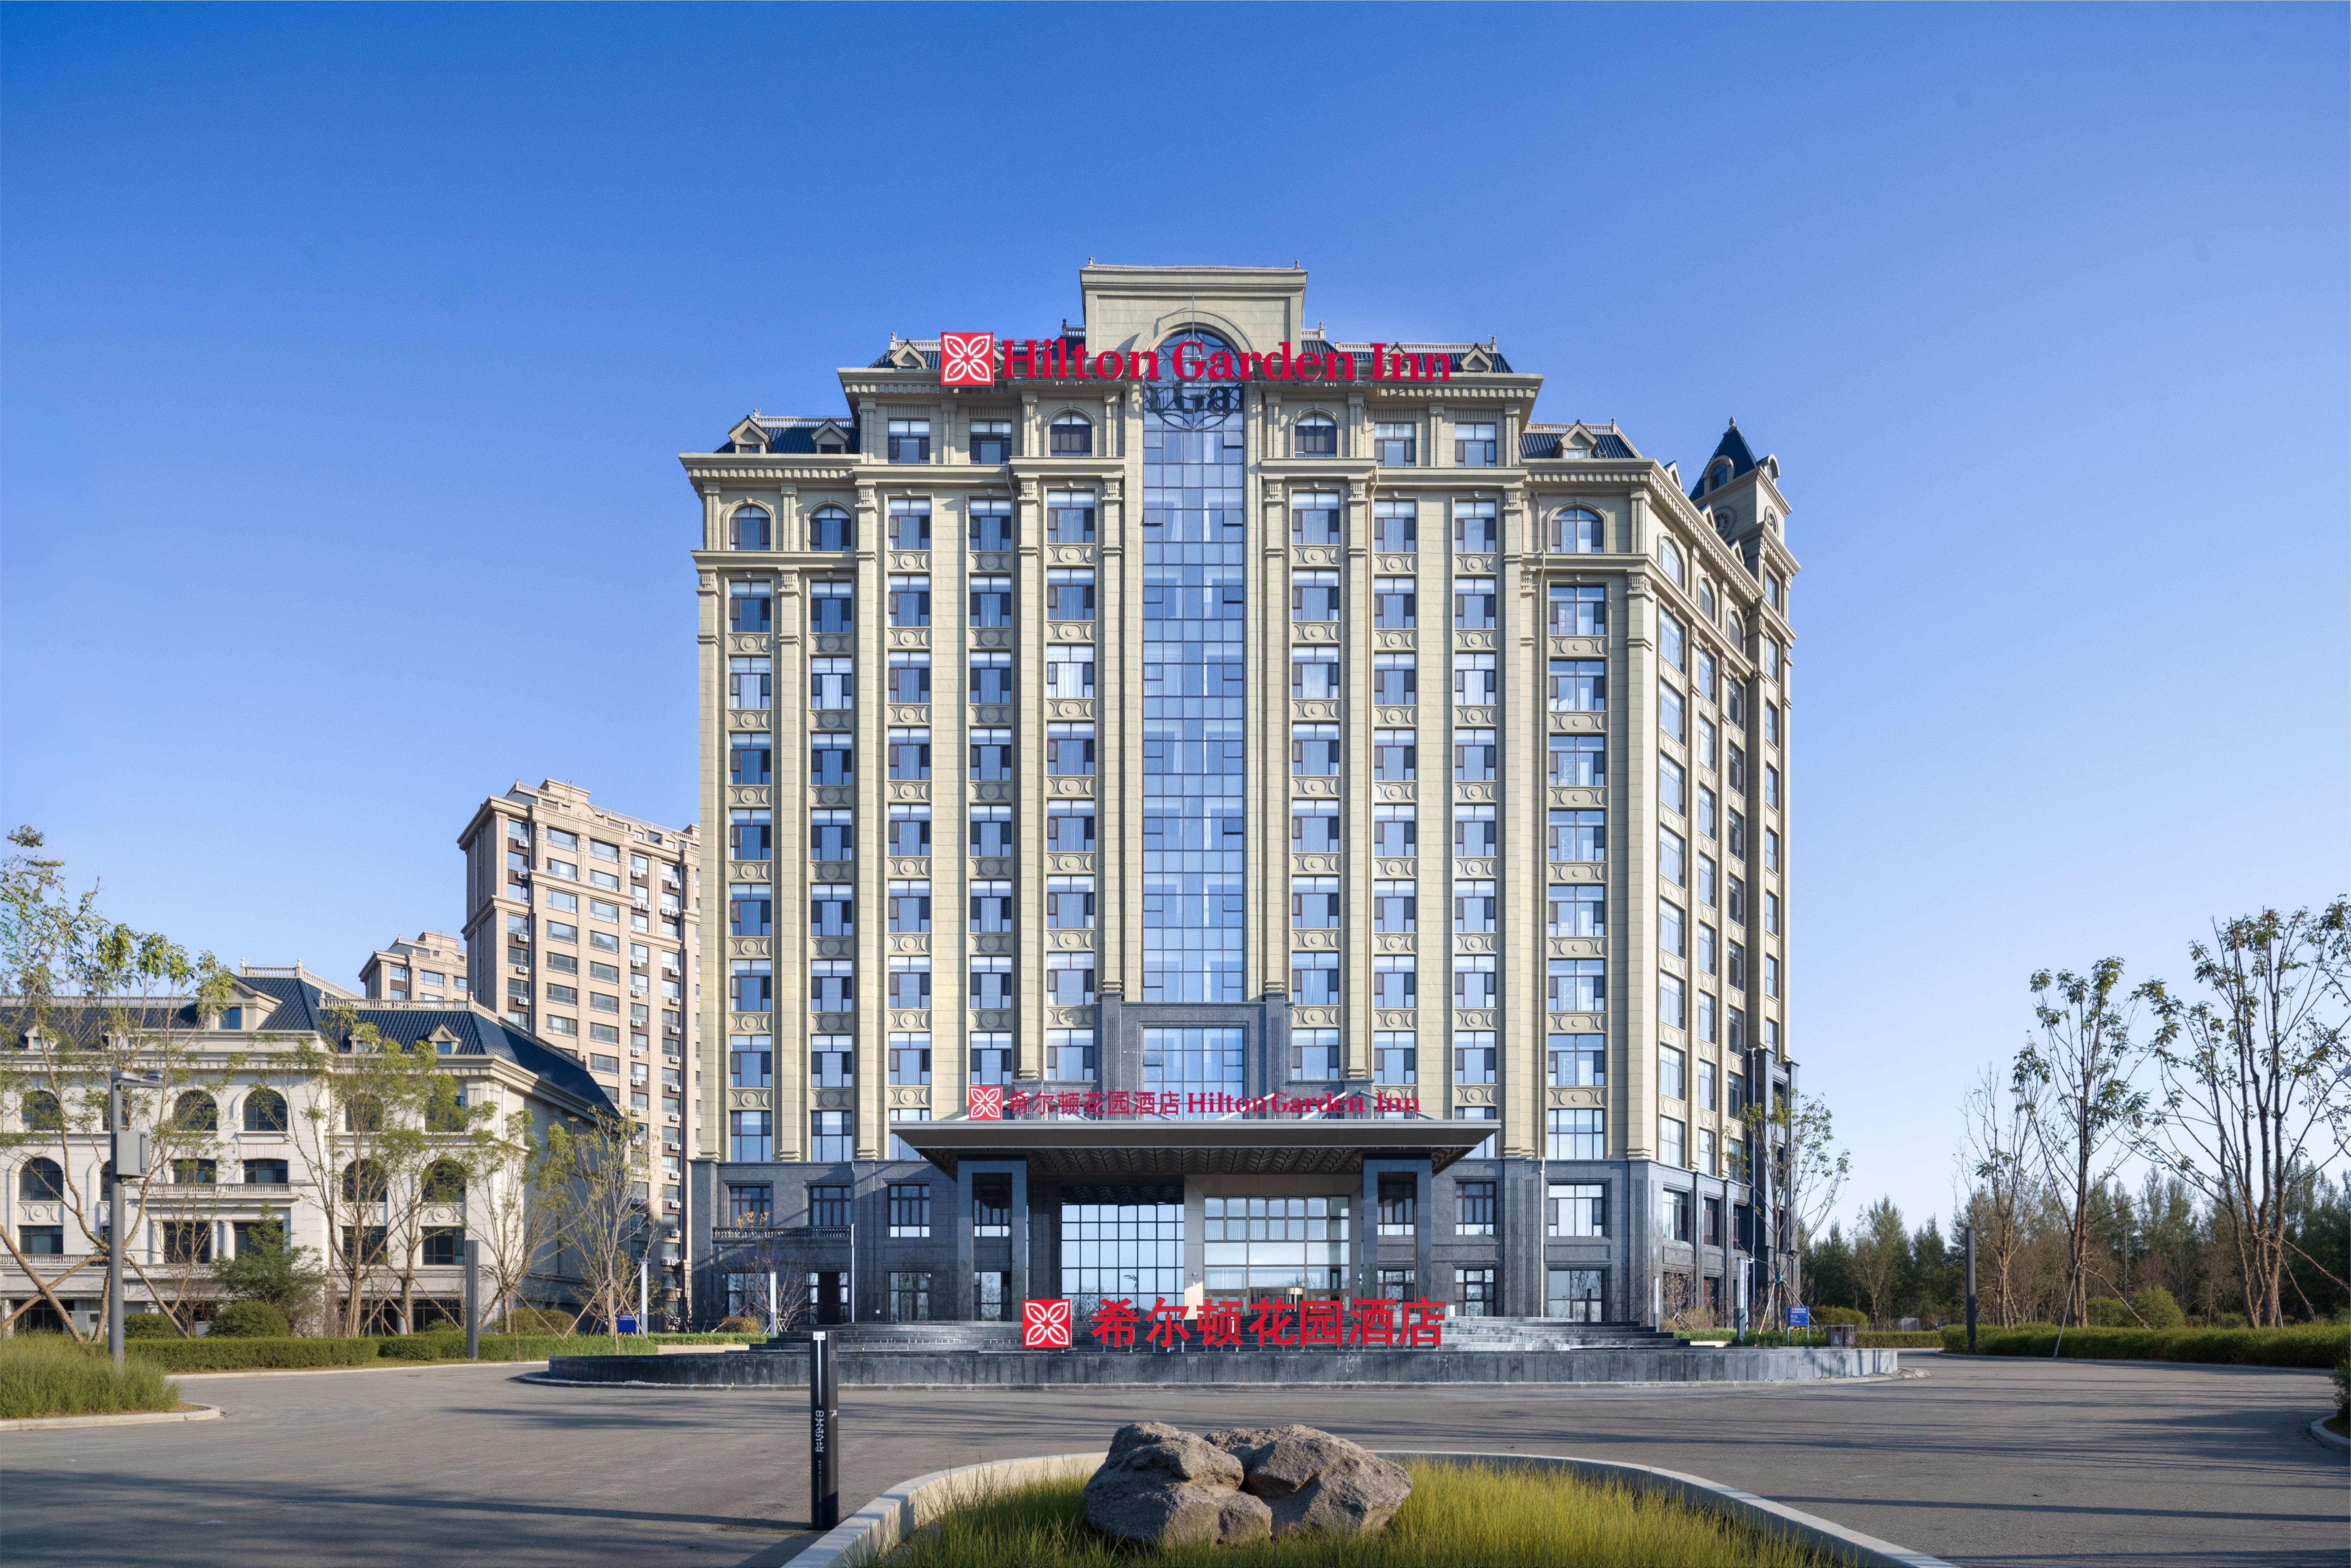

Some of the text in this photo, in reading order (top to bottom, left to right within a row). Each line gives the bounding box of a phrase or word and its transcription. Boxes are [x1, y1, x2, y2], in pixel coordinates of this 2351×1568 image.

[1002, 339, 1452, 382] Hilton Garden Inn
[1006, 1090, 1421, 1116] 希尔顿花园酒店 Hilton Garden Inn
[1091, 1296, 1446, 1348] 希尔顿花园酒店
